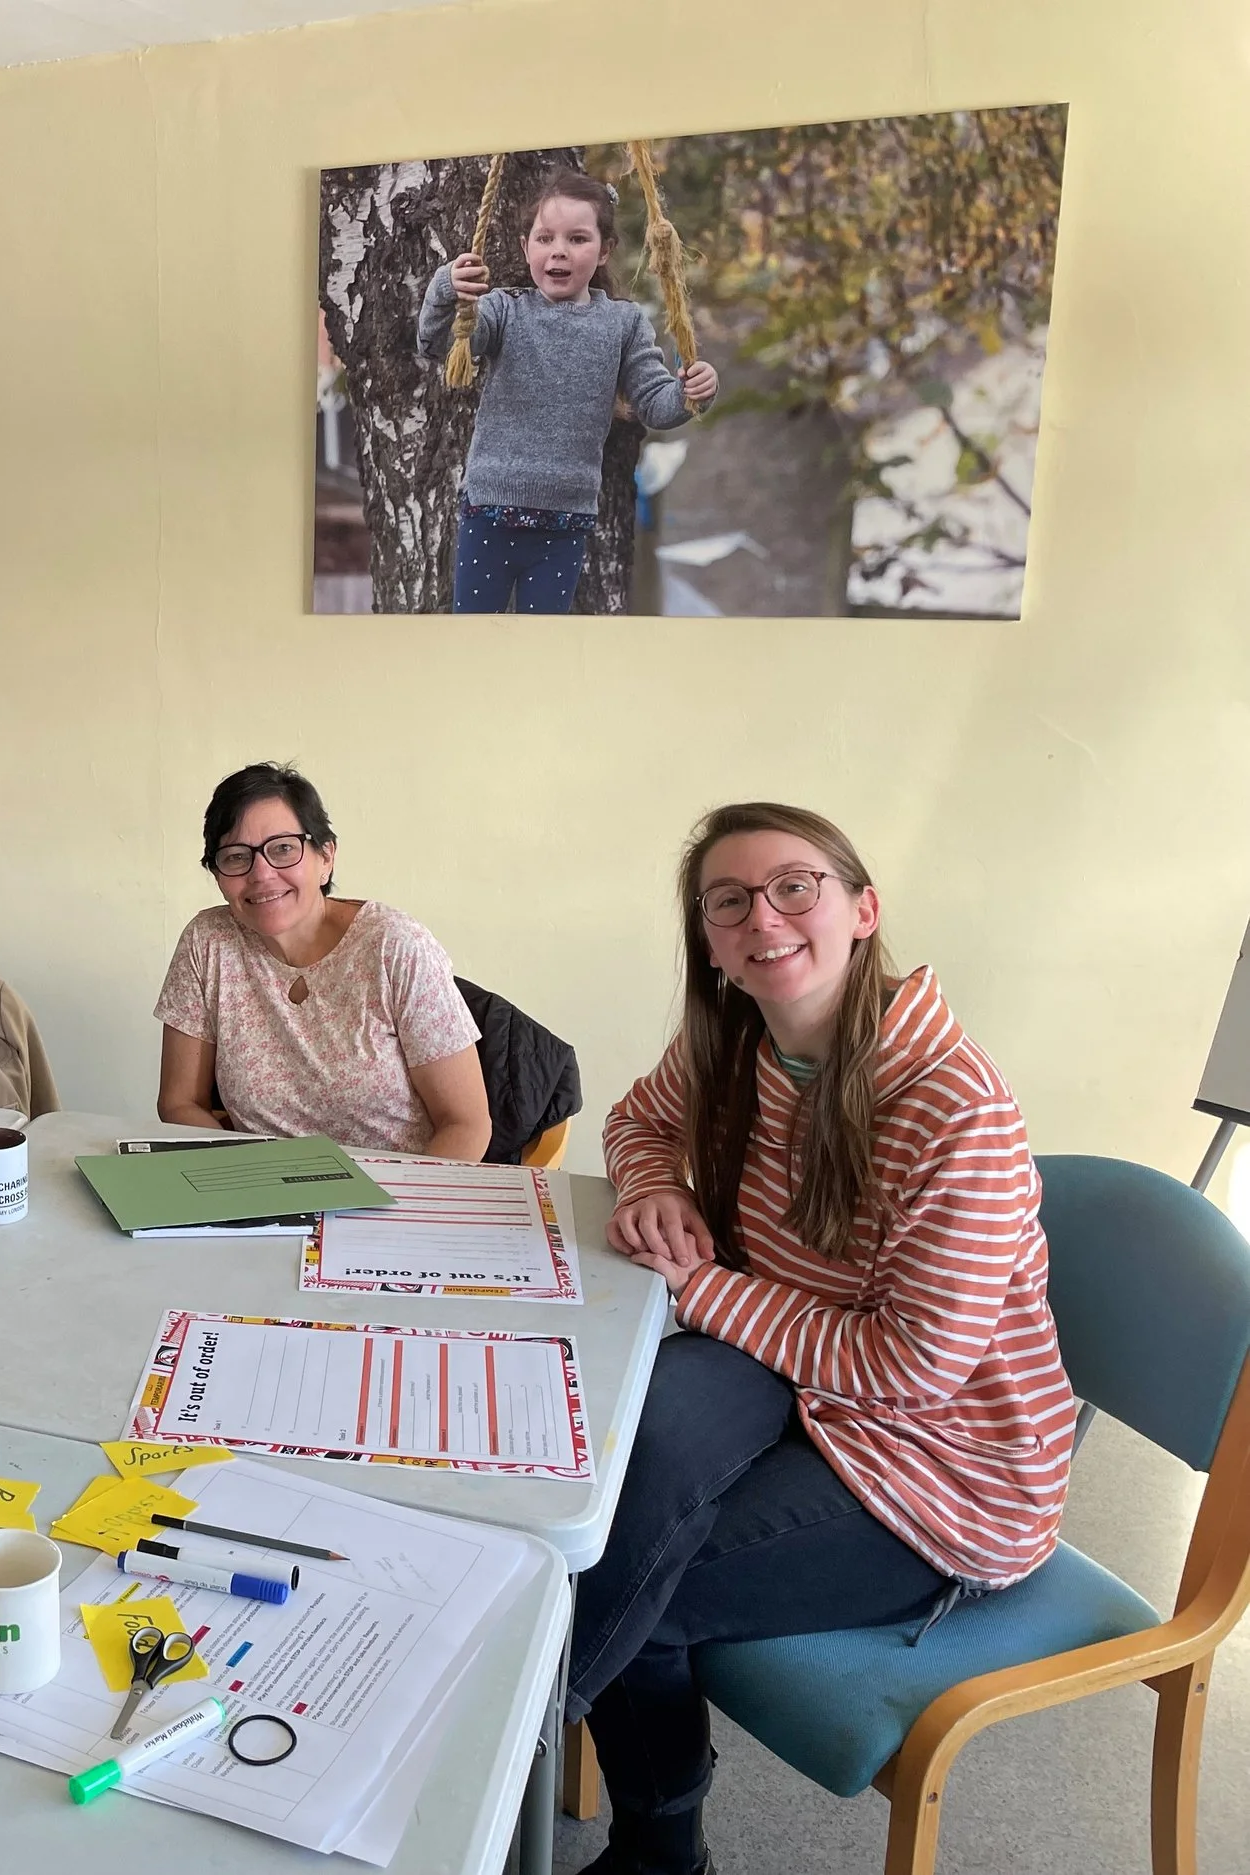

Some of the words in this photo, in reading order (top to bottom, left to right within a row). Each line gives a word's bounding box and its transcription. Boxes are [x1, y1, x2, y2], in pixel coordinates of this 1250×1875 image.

[9, 1204, 24, 1215] LONDON
[346, 1268, 413, 1277] order!
[449, 1272, 485, 1280] out
[198, 1332, 219, 1364] order!
[193, 1366, 210, 1379] of
[190, 1382, 206, 1401] out
[178, 1404, 201, 1422] It's
[123, 1445, 194, 1467] Sports
[289, 1648, 302, 1660] STOP
[342, 1665, 355, 1676] STOP
[166, 1710, 204, 1736] Whiteboard
[143, 1732, 168, 1750] Marker
